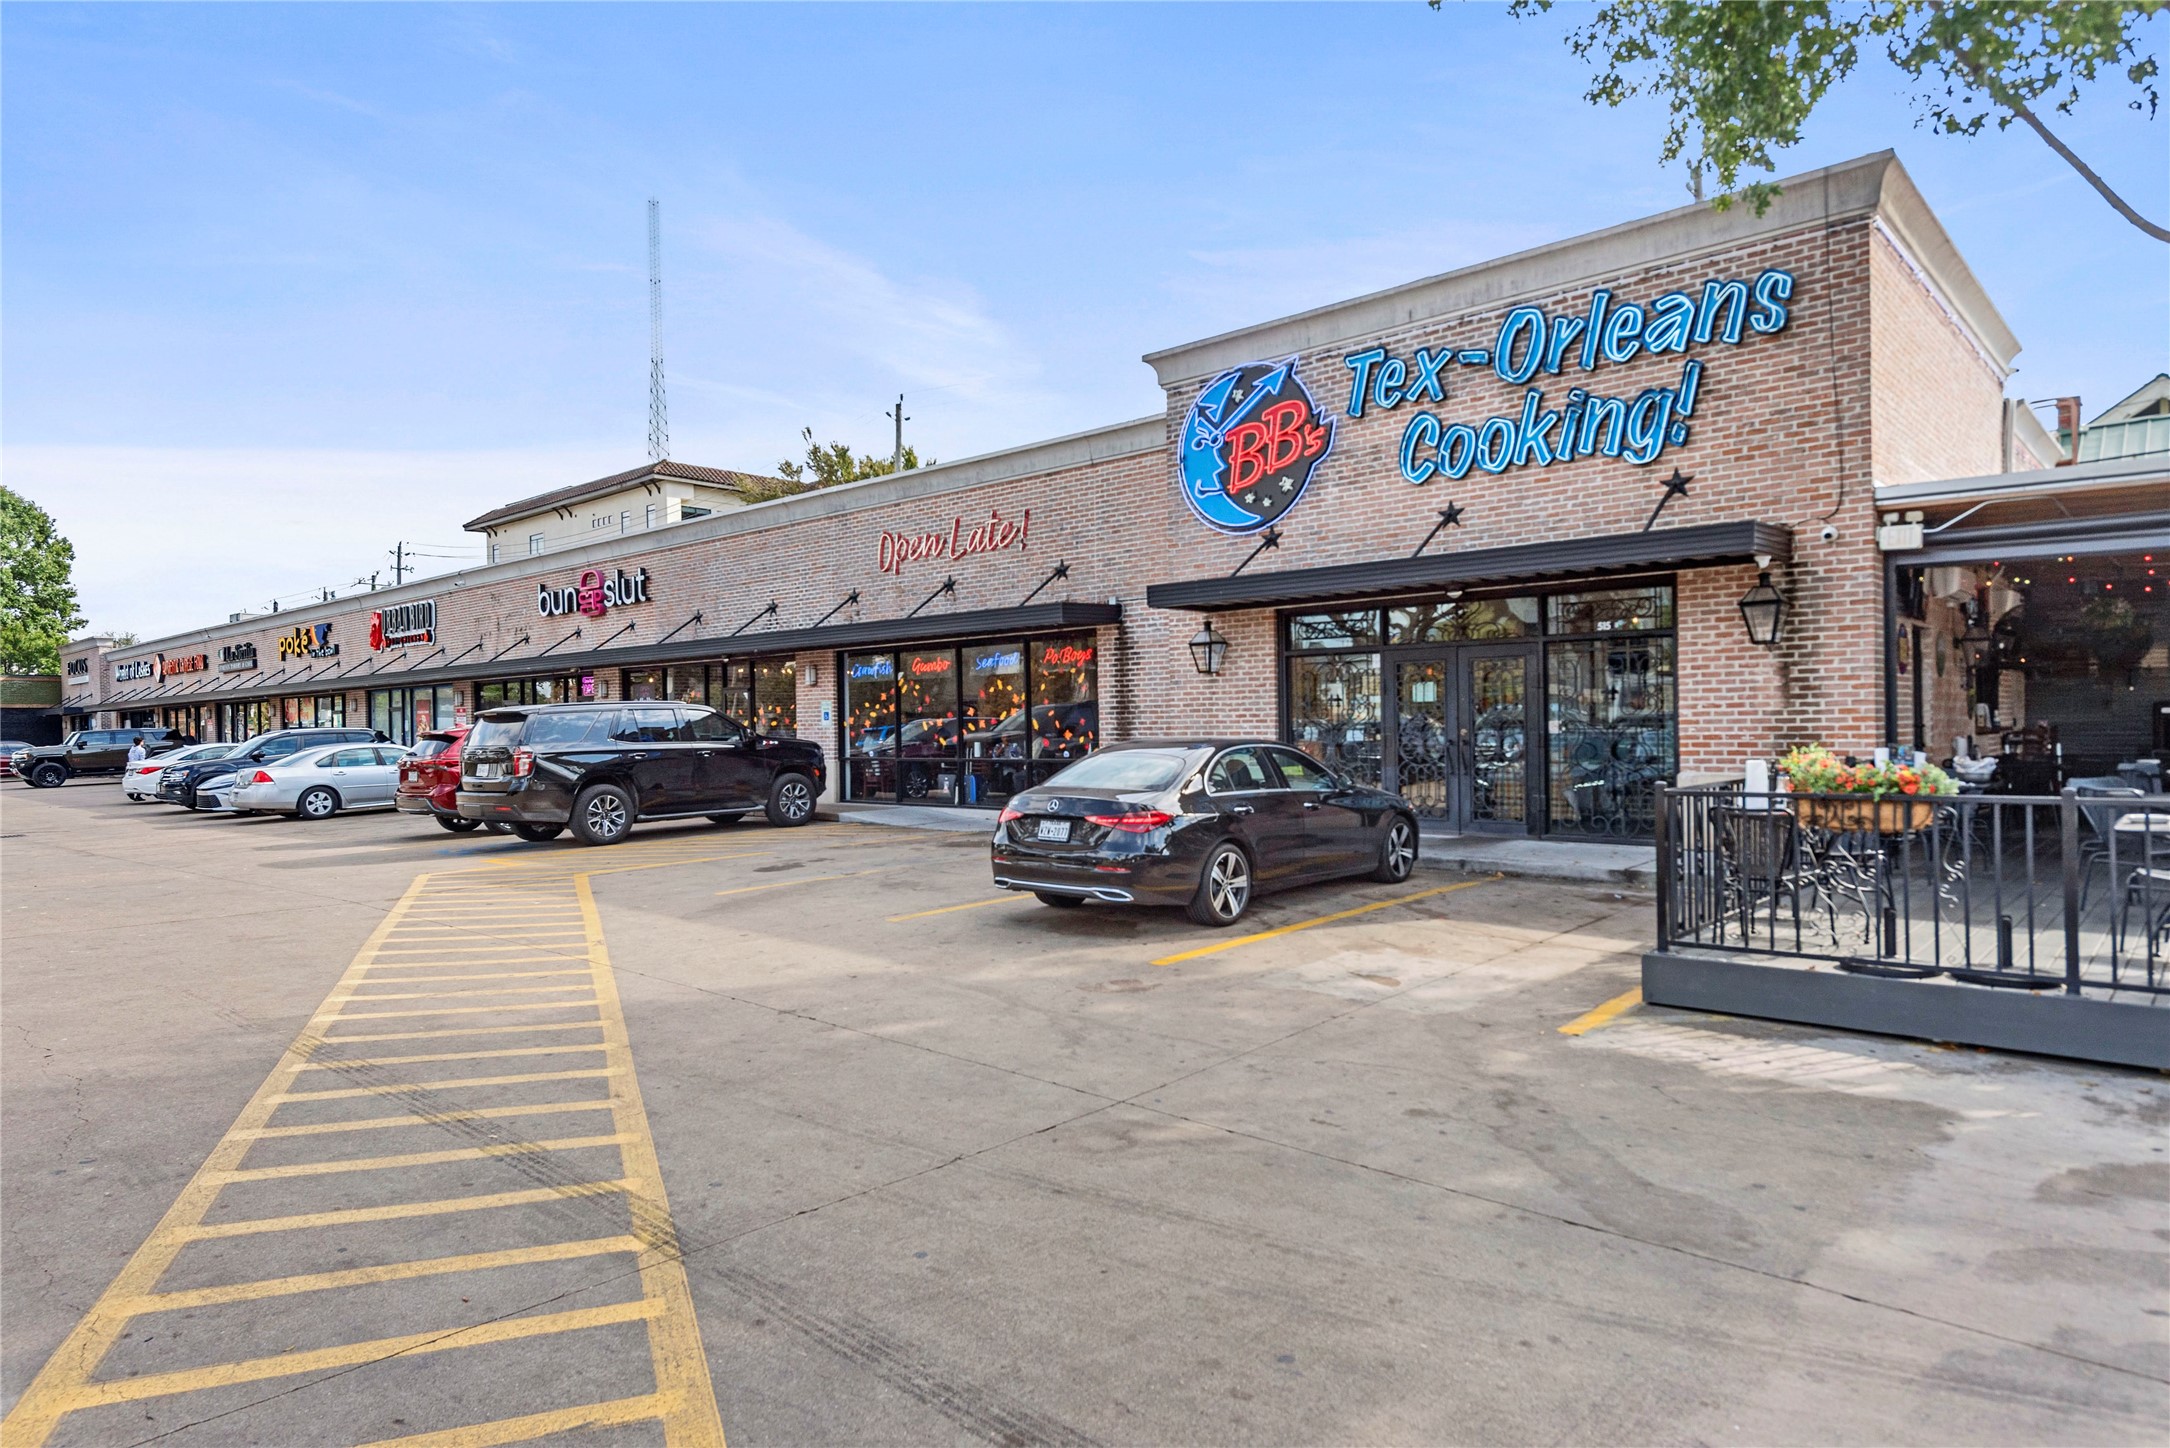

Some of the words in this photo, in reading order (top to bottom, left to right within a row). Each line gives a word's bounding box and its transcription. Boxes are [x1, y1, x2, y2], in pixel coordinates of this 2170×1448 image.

[1343, 268, 1793, 418] Tex-Orleans
[1398, 346, 1705, 486] Cooking!
[1225, 400, 1326, 494] BB's
[878, 531, 947, 575] Open
[948, 508, 1032, 560] Late!
[538, 583, 581, 617] bun
[603, 567, 650, 607] slut
[381, 605, 409, 634] URBAN
[409, 602, 431, 631] BIRD
[1597, 620, 1611, 631] 515
[278, 627, 310, 661] poké
[975, 651, 1020, 671] Seafood
[852, 661, 893, 679] Crawfish
[912, 656, 950, 676] Gumbo
